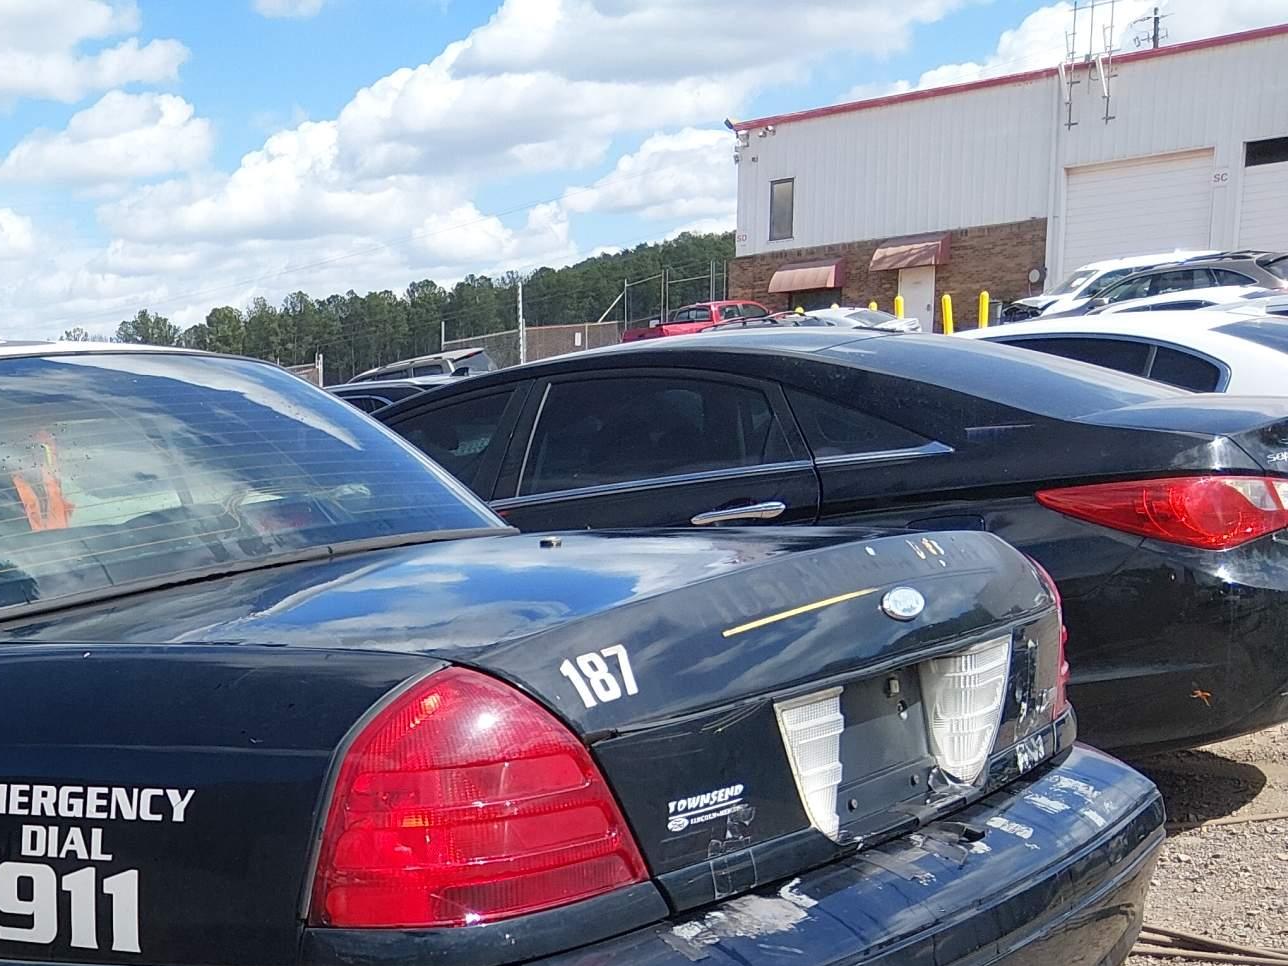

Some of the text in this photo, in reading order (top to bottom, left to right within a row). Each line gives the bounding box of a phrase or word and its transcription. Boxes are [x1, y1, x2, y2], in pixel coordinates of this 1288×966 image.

[1213, 172, 1228, 183] SC
[559, 644, 638, 709] 187
[668, 784, 744, 814] TOWNSEND
[20, 824, 112, 861] DIAL
